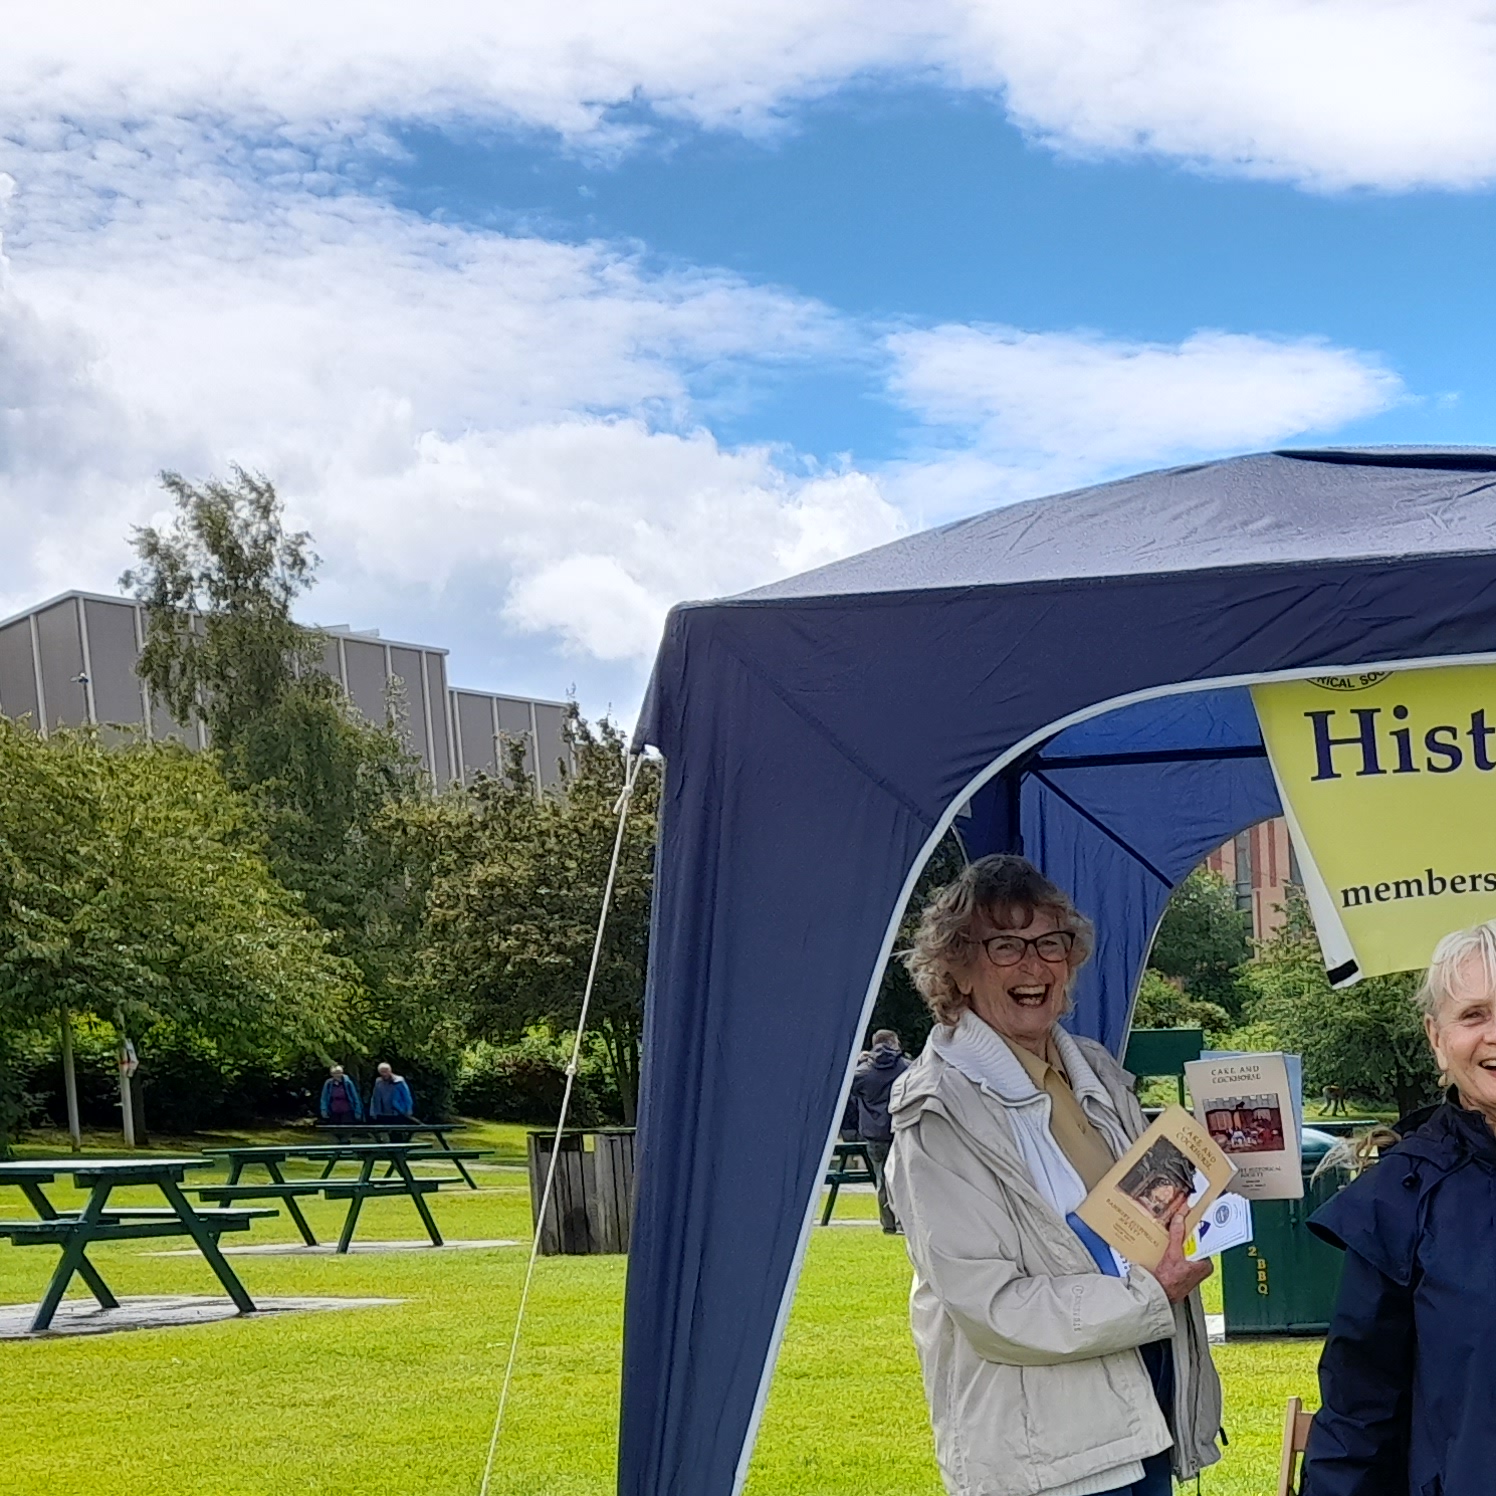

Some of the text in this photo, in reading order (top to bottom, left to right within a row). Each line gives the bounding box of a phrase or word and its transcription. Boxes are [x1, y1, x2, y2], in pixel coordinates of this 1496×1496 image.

[1211, 1065, 1260, 1076] CAKE AND
[1182, 1126, 1217, 1164] CAKE AND
[1247, 1245, 1258, 1257] 2
[1257, 1258, 1269, 1295] BBQ
